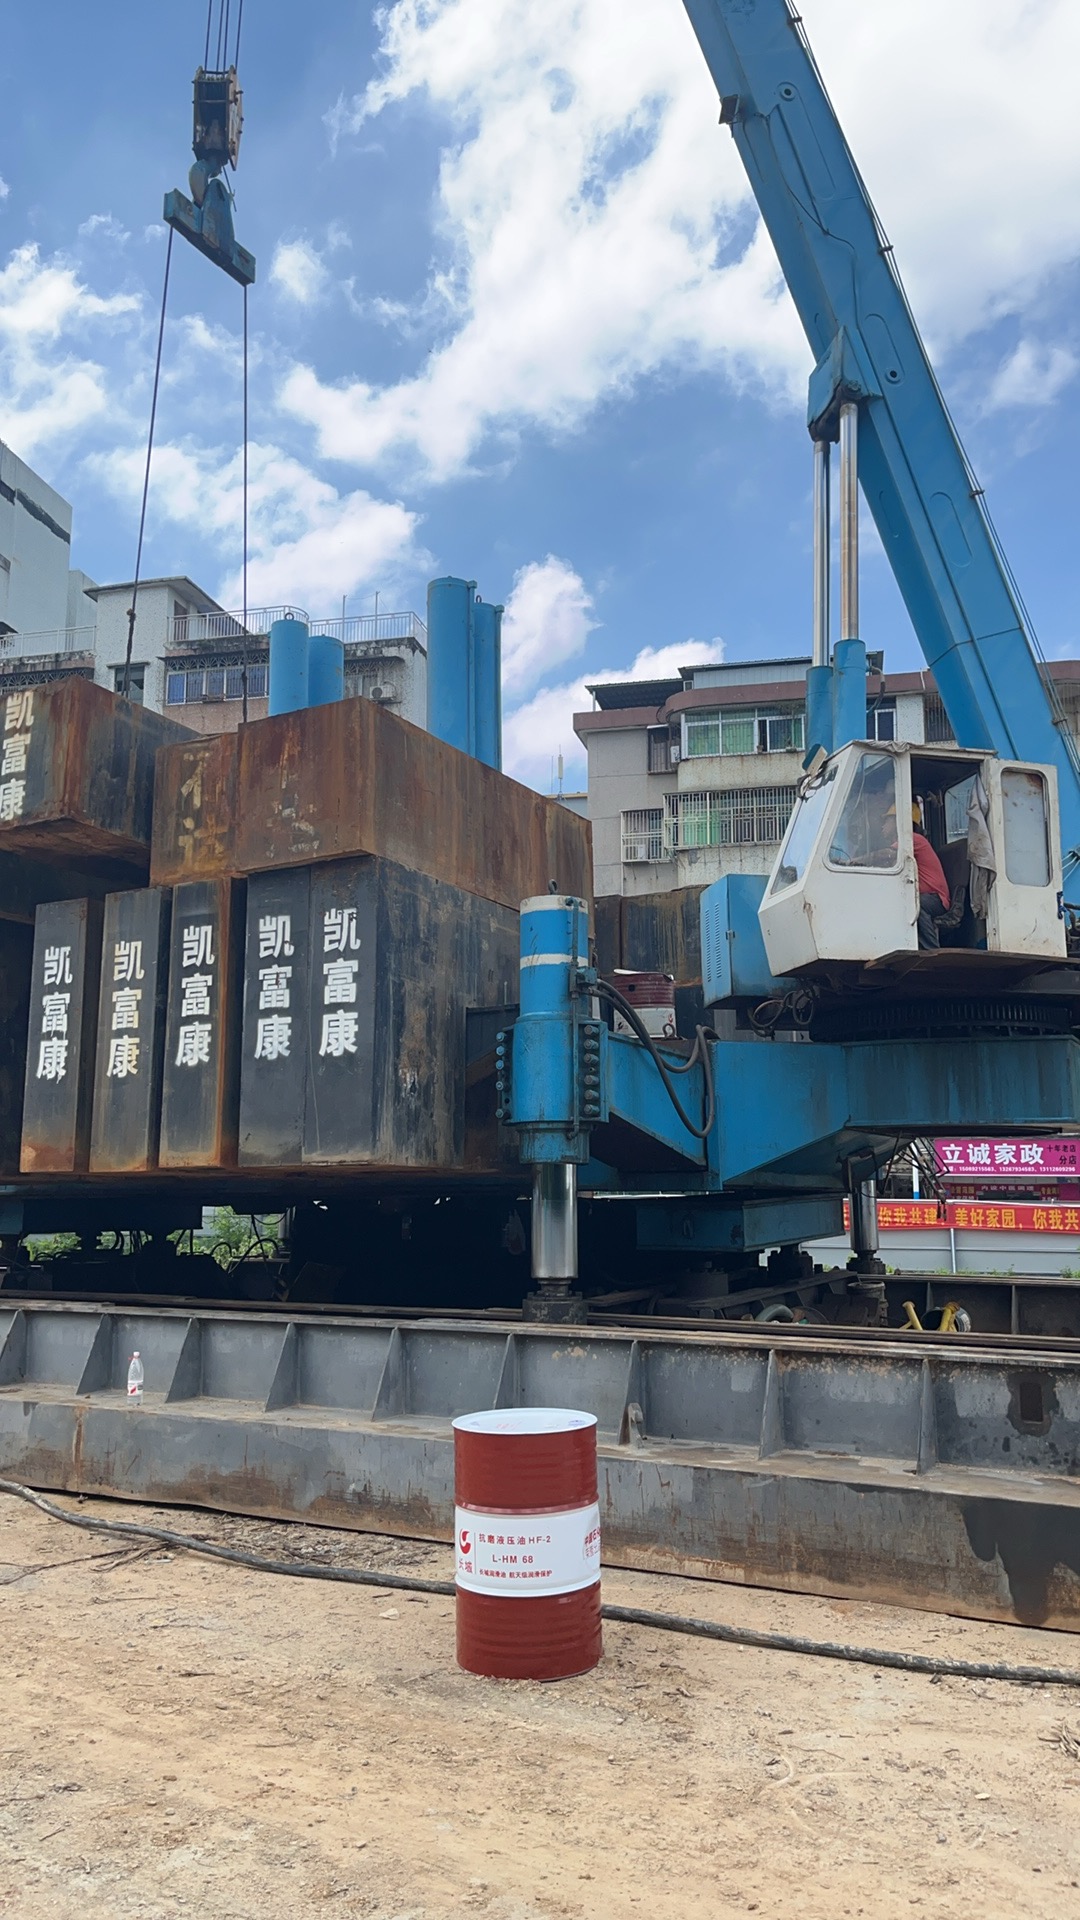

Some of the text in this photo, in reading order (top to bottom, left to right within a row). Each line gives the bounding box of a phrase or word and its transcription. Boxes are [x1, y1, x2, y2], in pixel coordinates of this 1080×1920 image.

[0, 691, 34, 821] 凯富康
[36, 946, 73, 1083] 凯富康
[106, 940, 145, 1078] 凯富康
[176, 925, 215, 1067] 凯富康
[254, 915, 294, 1060] 凯富康
[319, 908, 361, 1057] 凯富康
[942, 1143, 1044, 1165] 立诚家政
[1059, 1155, 1077, 1165] 分店
[479, 1533, 551, 1545] 抗磨液压油 HF-2
[492, 1554, 534, 1564] L-HM 68
